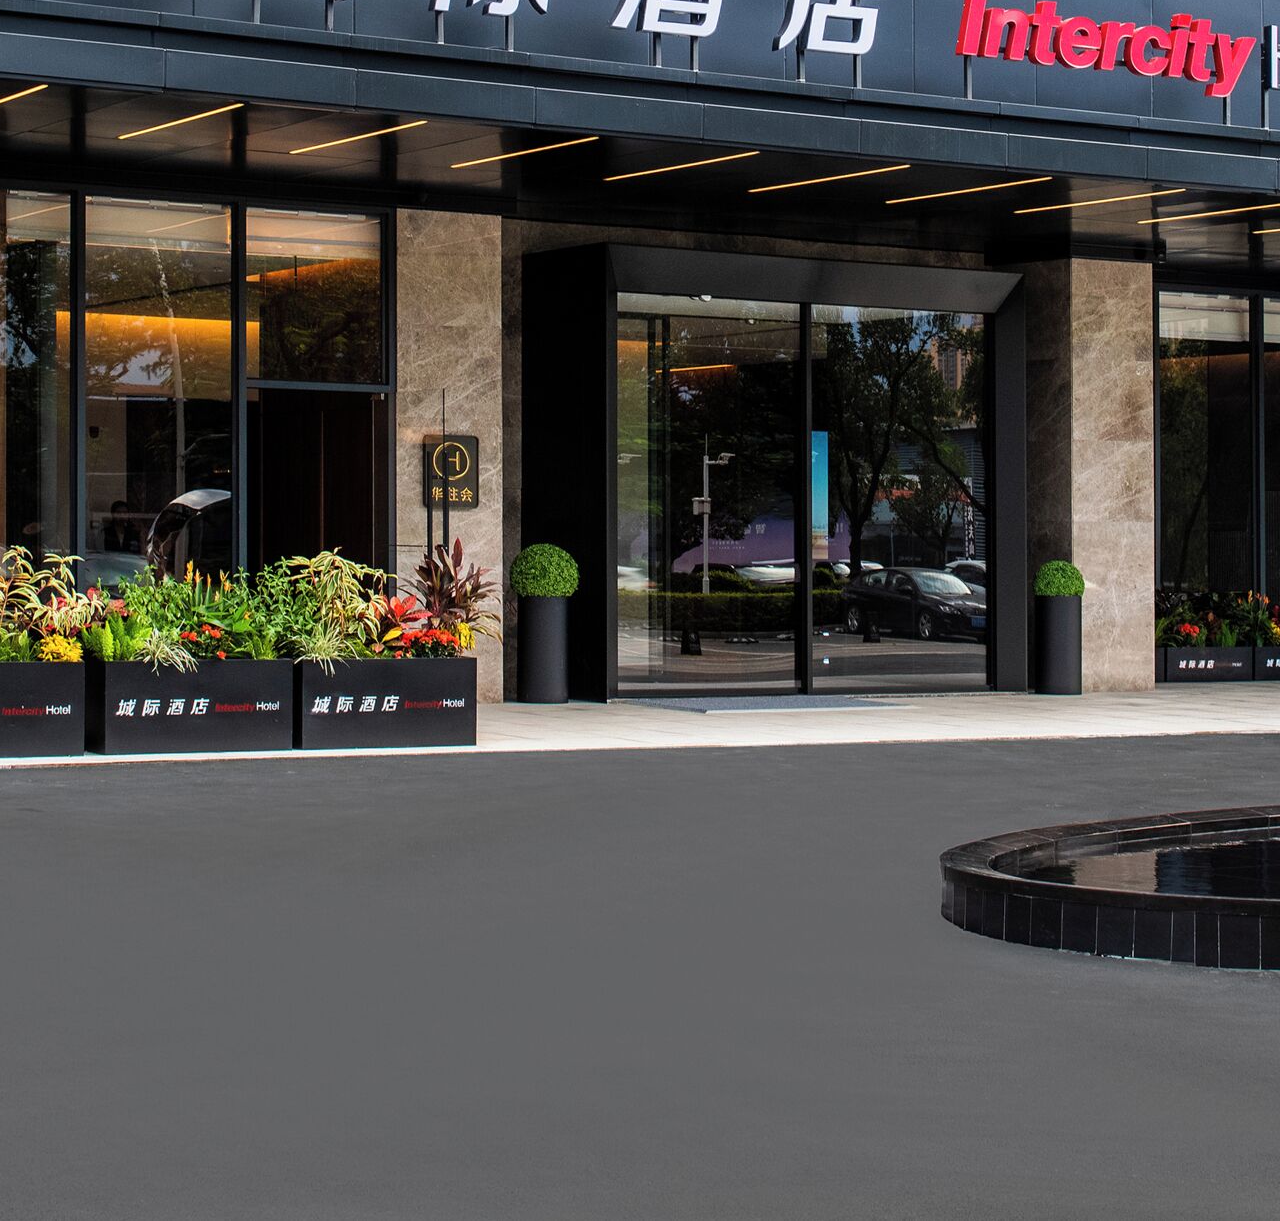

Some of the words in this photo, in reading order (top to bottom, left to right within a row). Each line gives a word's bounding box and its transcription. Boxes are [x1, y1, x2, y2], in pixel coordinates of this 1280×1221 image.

[115, 697, 210, 717] 城际酒店
[256, 700, 280, 711] Hotel
[311, 694, 400, 714] 城际酒店
[442, 697, 465, 708] Hotel
[45, 704, 71, 715] Hotel
